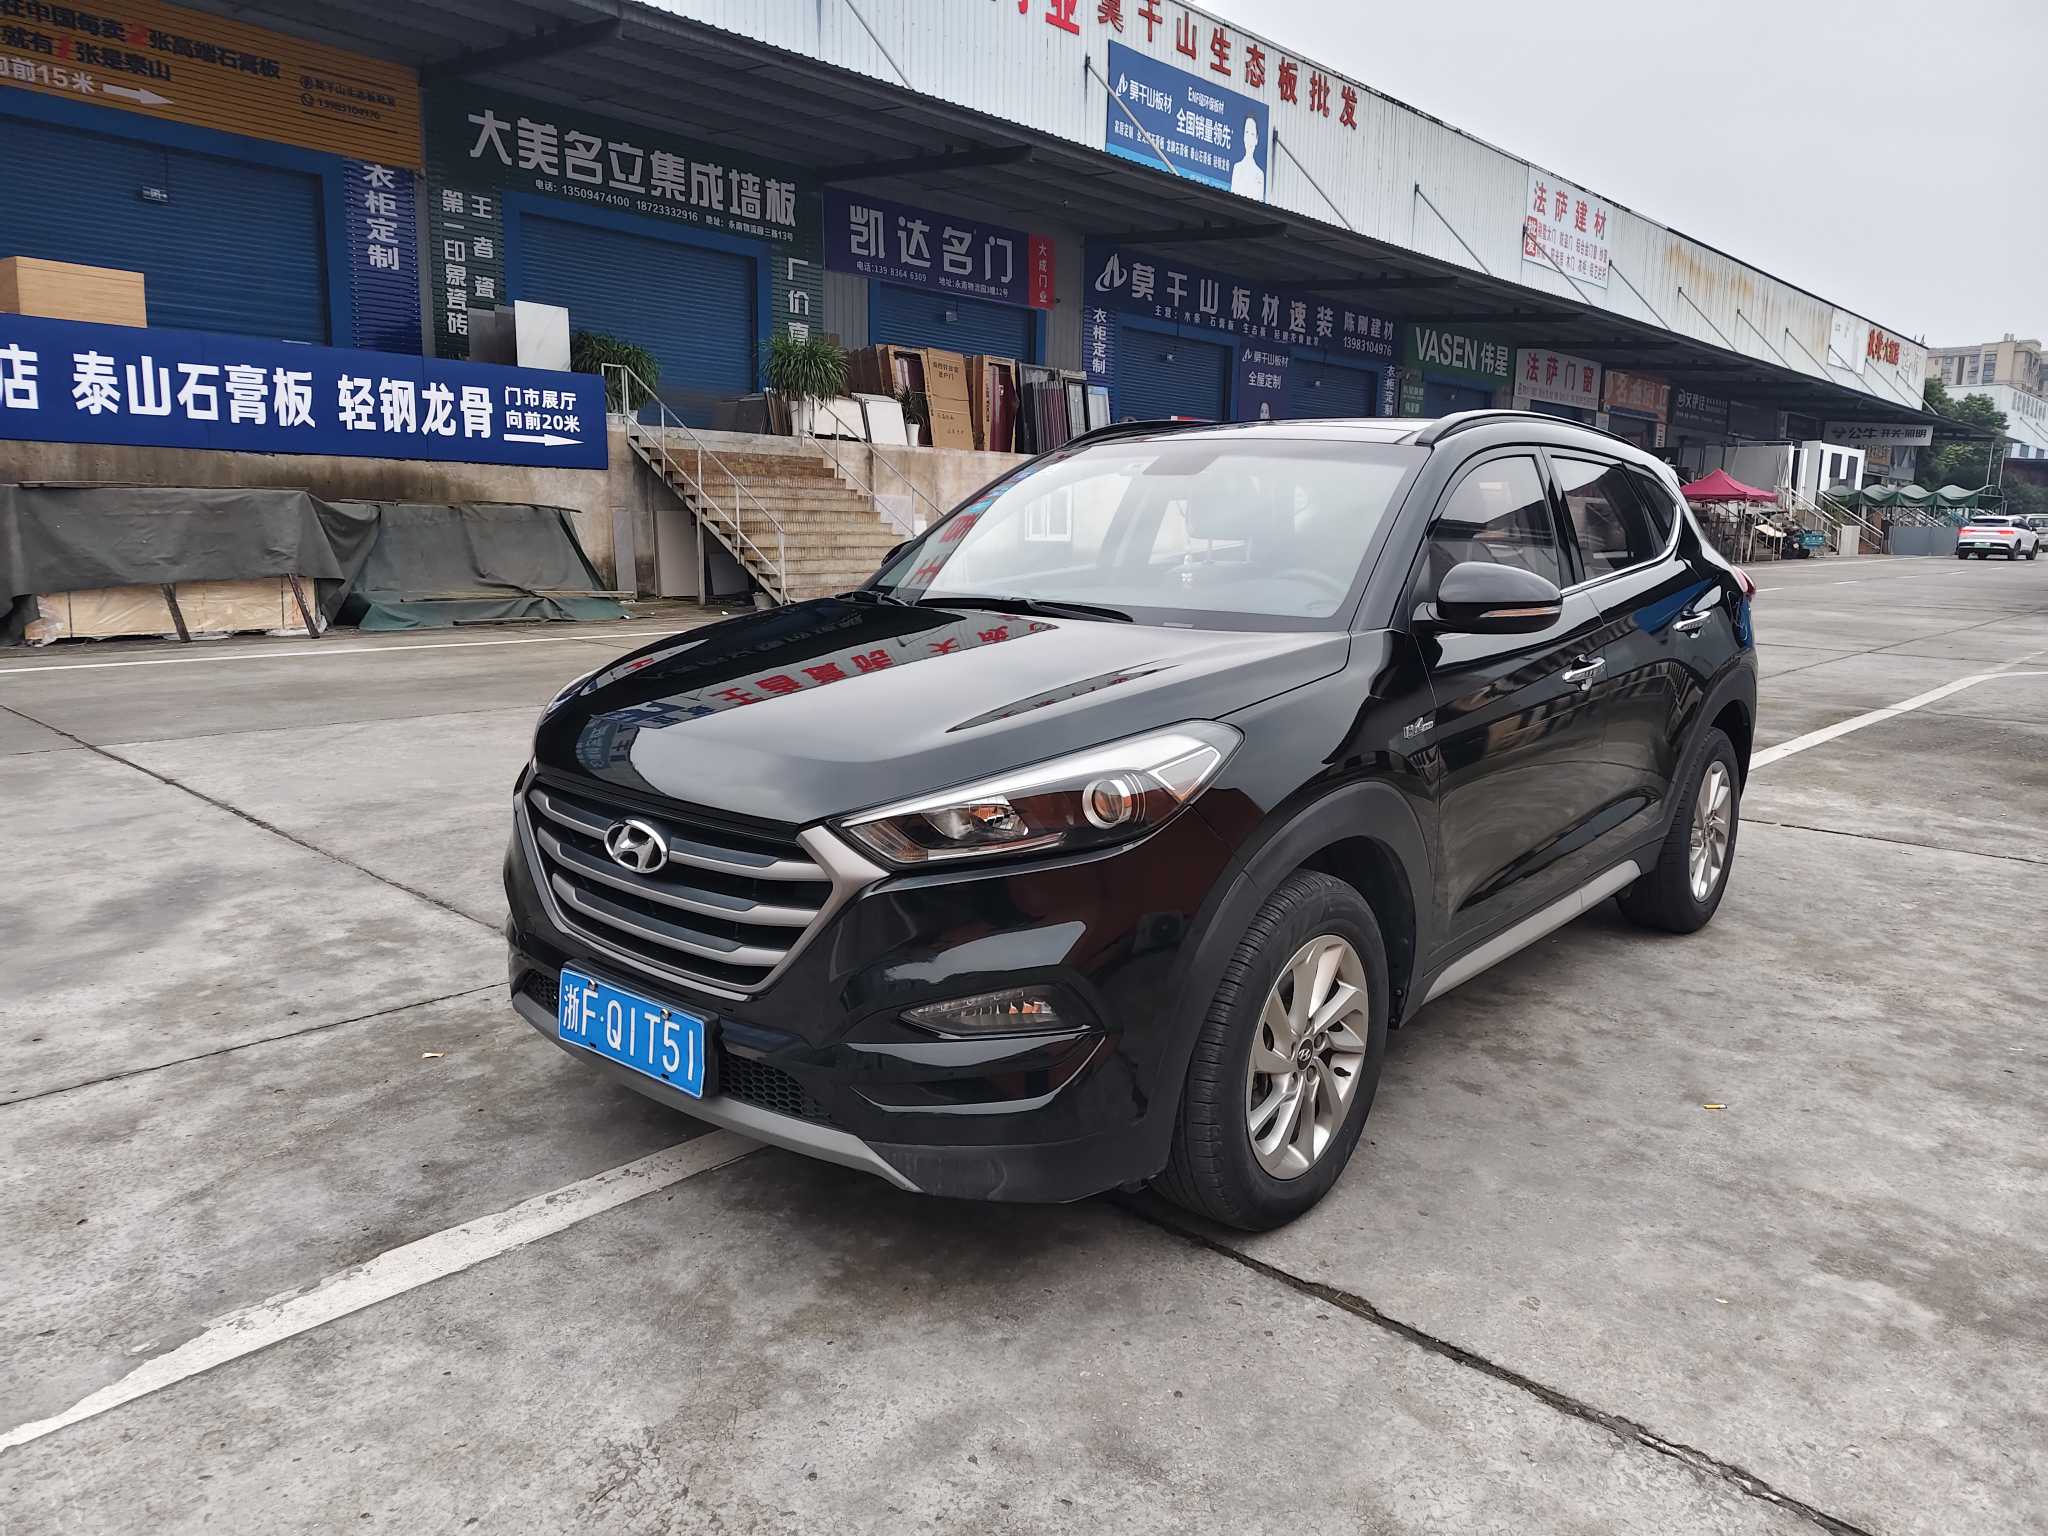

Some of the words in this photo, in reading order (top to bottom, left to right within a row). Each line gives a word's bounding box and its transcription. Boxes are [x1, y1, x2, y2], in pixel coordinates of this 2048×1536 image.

[1097, 0, 1358, 130] 莫干山生态板批发
[1129, 79, 1173, 114] 莫干山板材
[1176, 107, 1231, 150] 全国销量领先
[468, 108, 796, 227] 大美名立集成墙板
[363, 163, 399, 271] 衣柜定制
[636, 200, 698, 222] 18723332916
[1534, 180, 1606, 241] 法萨建材
[441, 190, 468, 336] 第一印象瓷砖
[850, 204, 1013, 284] 凯达名门
[1131, 261, 1334, 339] 莫干山板材速装
[1092, 307, 1106, 375] 衣柜定制
[1343, 336, 1392, 357] 13983104976
[1415, 326, 1477, 371] VASEN
[72, 350, 316, 429] 泰山石膏板
[338, 373, 494, 439] 轻钢龙骨
[504, 385, 577, 411] 门市展厅
[1248, 371, 1282, 390] 全屋定制
[505, 409, 581, 434] 向前20米
